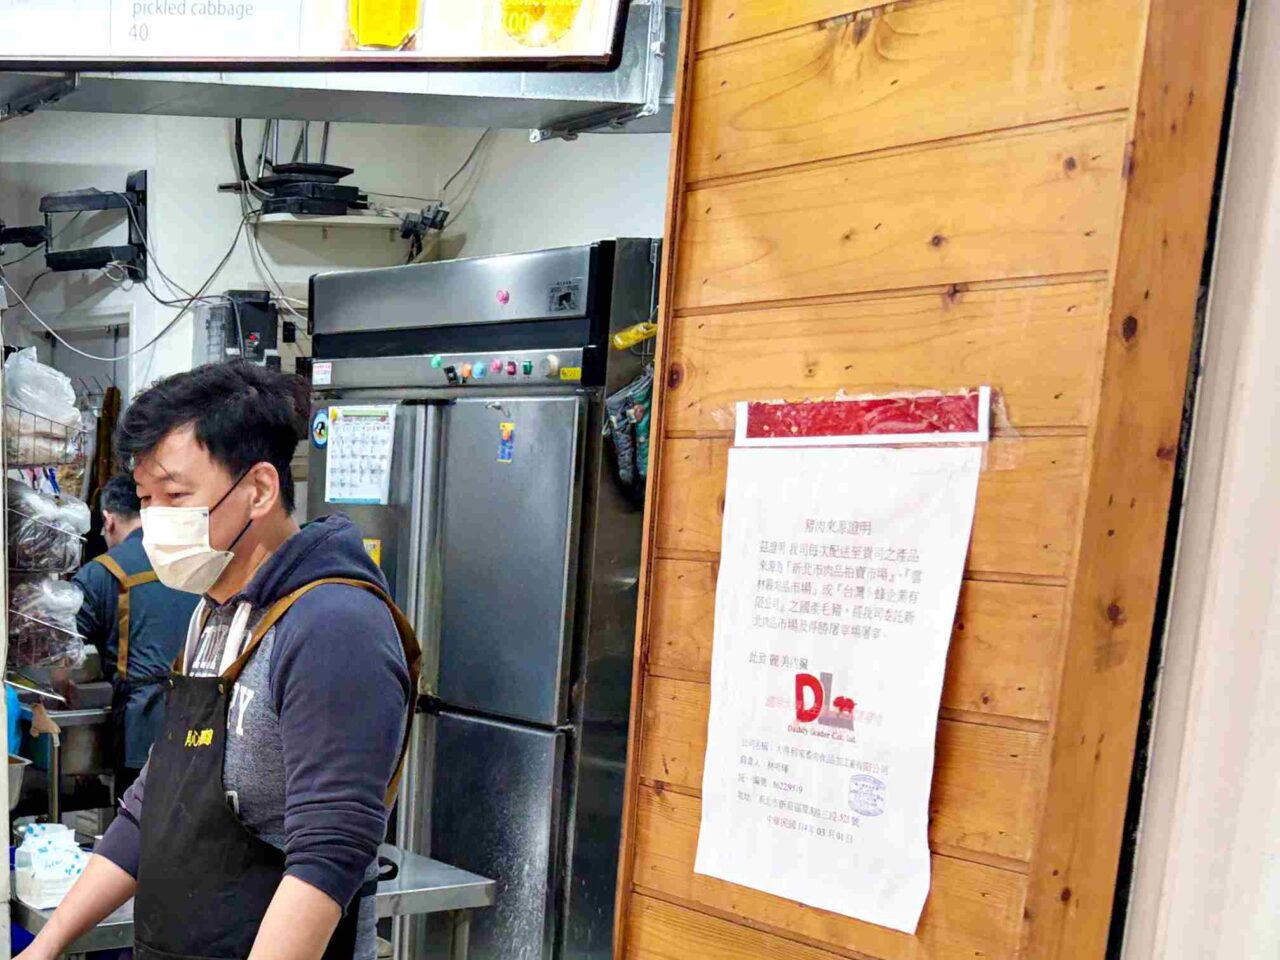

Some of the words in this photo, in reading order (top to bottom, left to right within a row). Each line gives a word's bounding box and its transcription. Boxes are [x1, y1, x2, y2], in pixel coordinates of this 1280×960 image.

[132, 0, 186, 19] pickled
[191, 0, 254, 20] cabbage
[128, 23, 149, 41] 40
